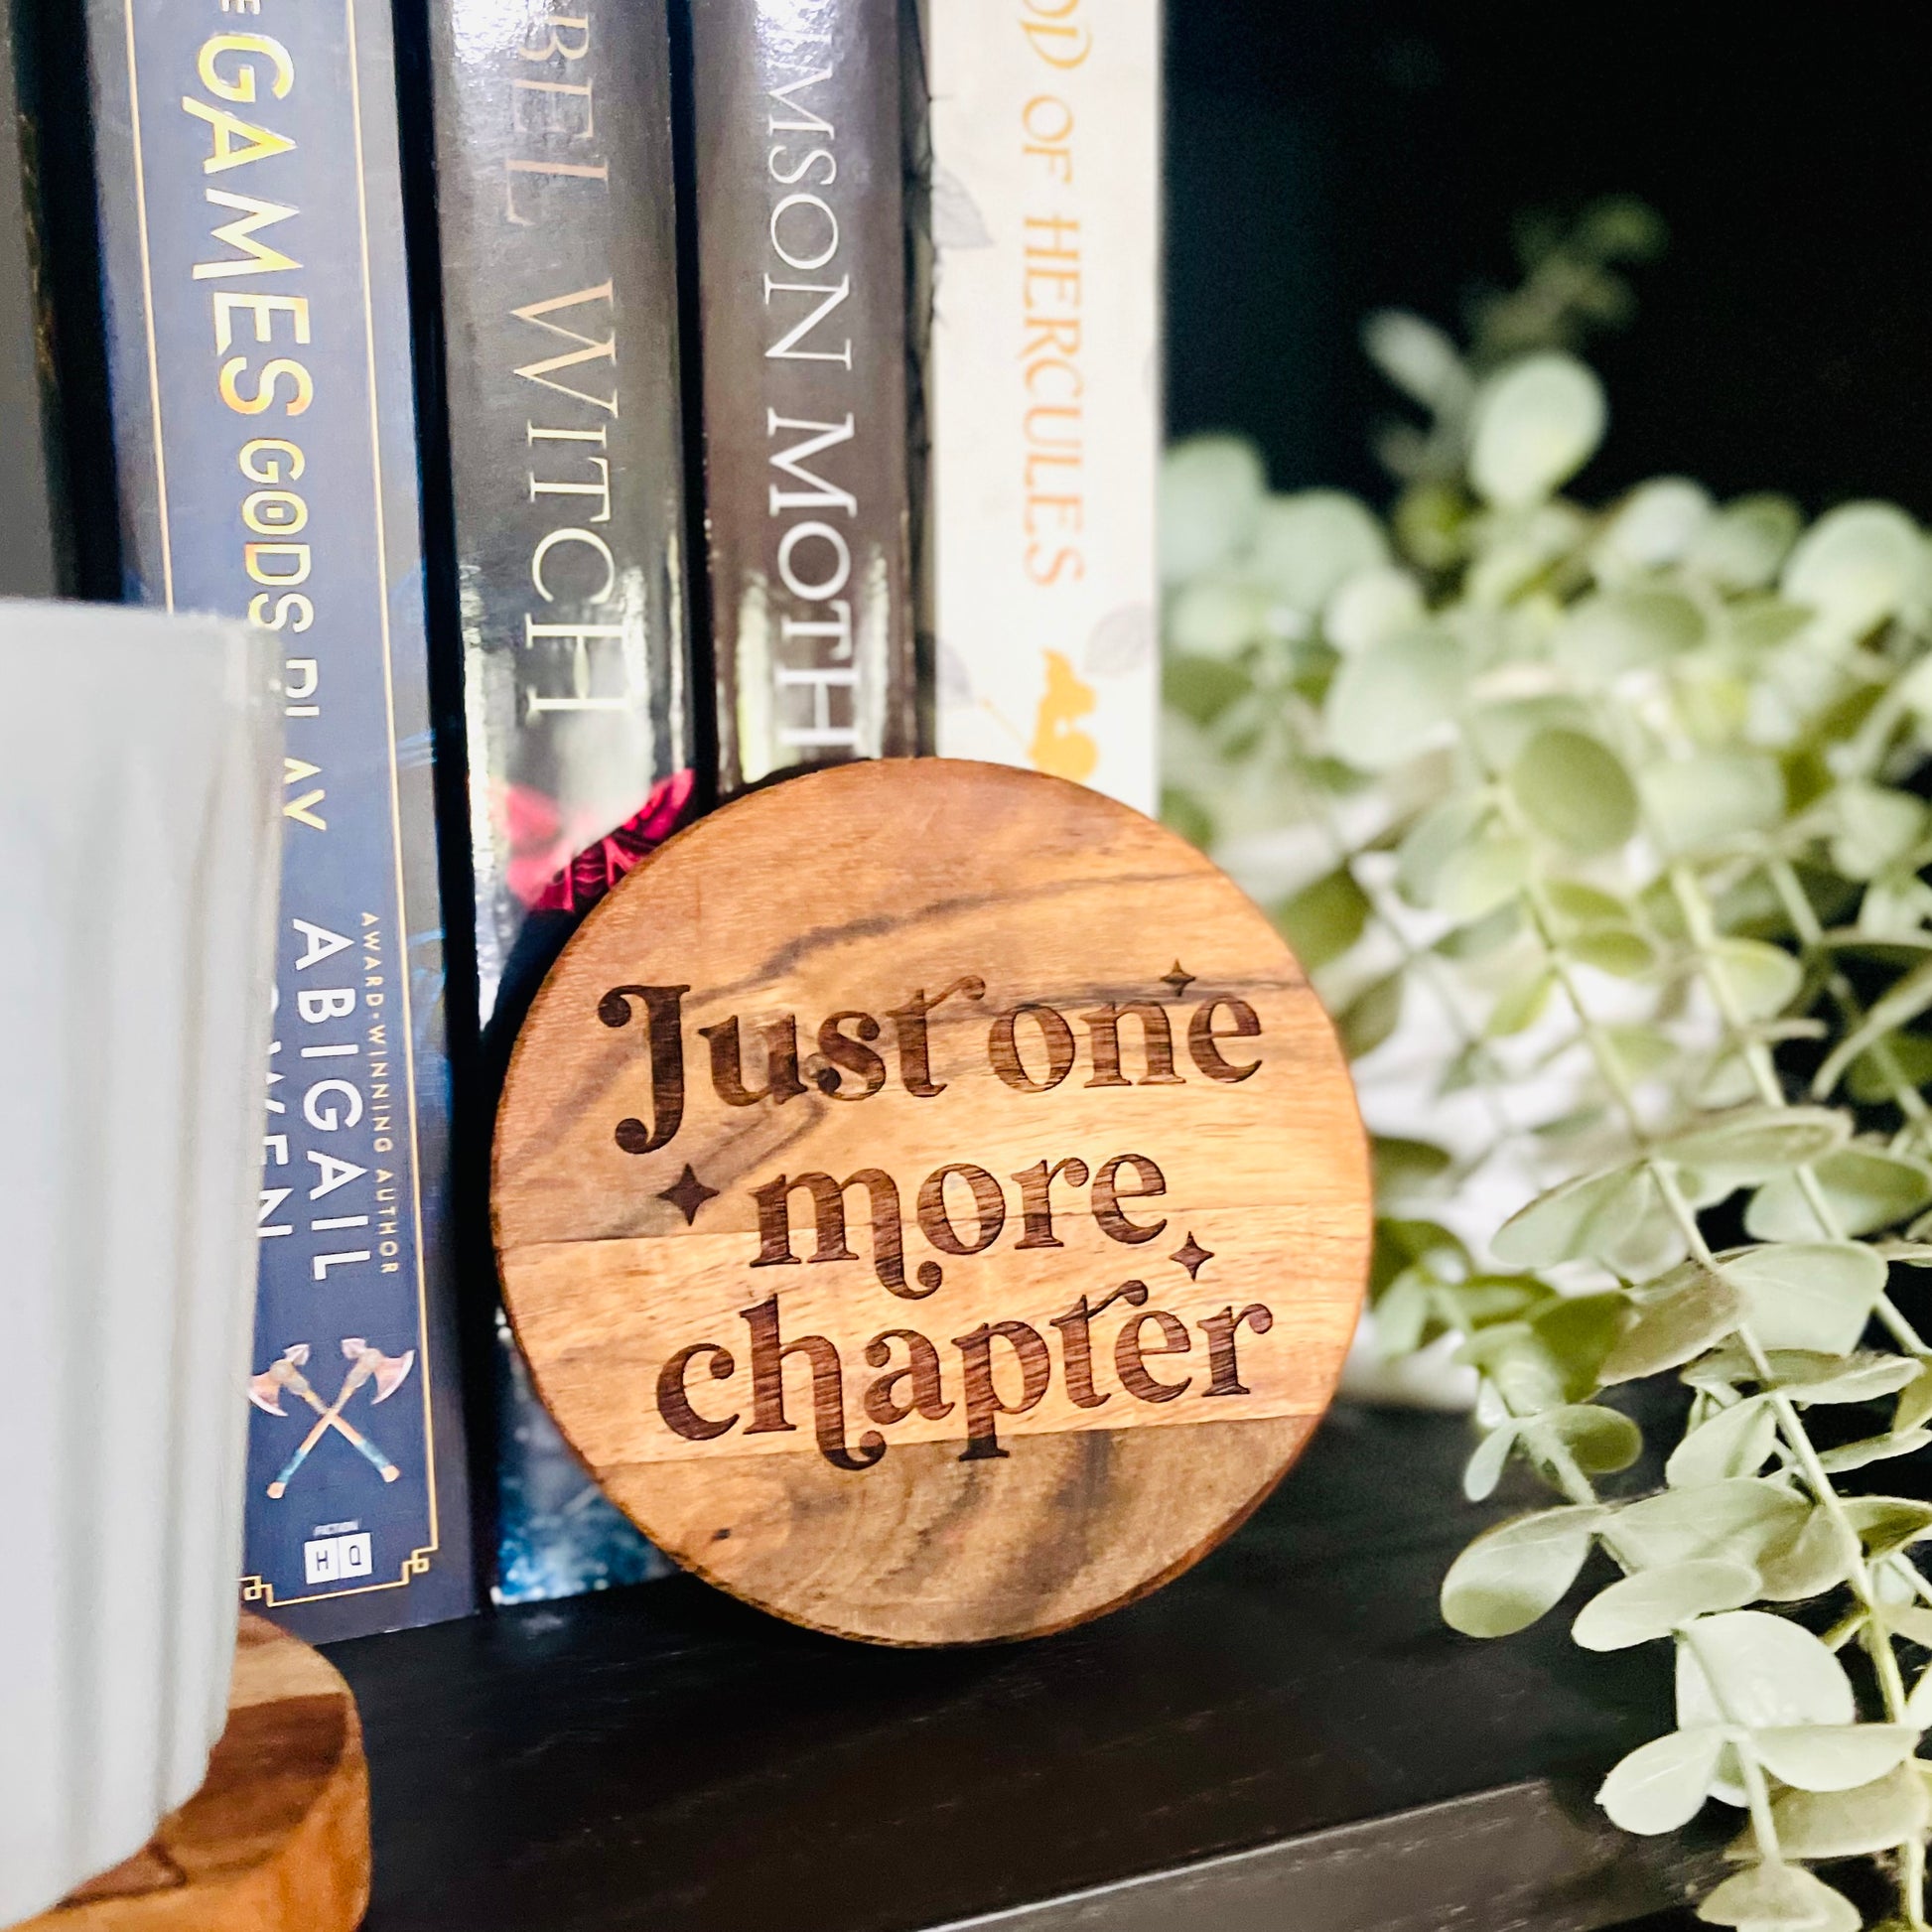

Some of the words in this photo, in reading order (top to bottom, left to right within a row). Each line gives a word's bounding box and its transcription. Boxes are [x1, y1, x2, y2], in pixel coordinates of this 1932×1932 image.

[182, 32, 314, 417] GAMES
[1022, 94, 1074, 185] OF
[509, 277, 629, 719] WITCH
[1018, 214, 1085, 587] HERCULES
[238, 438, 315, 633] GODS
[765, 408, 864, 754] MOTH
[293, 917, 371, 1281] ABIGAIL
[597, 974, 987, 1155] Just
[987, 994, 1264, 1093] one
[375, 1168, 399, 1275] AUTHOR
[747, 1153, 1169, 1301] more
[656, 1279, 1275, 1471] chapter
